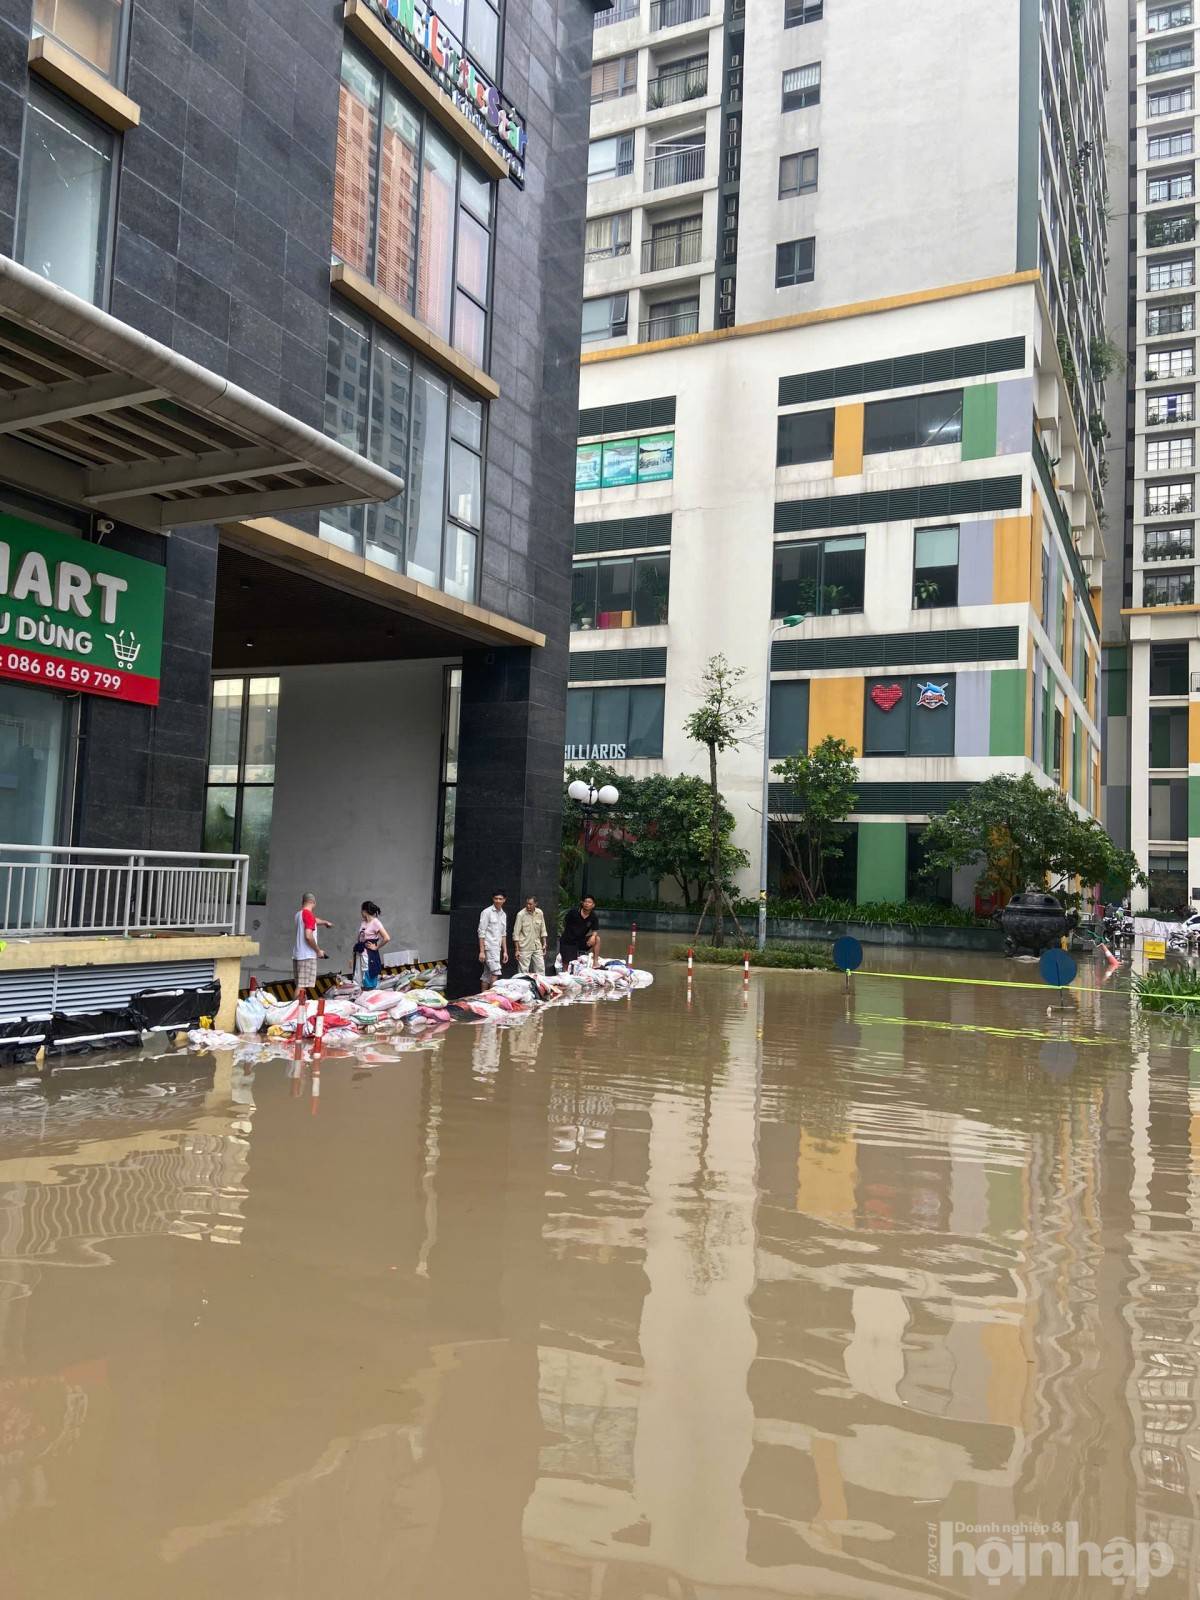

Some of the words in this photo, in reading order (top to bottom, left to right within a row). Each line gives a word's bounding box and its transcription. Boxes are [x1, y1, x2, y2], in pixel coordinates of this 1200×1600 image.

[0, 541, 128, 624] ART
[18, 614, 93, 654] DÙNG
[7, 653, 41, 674] 086
[45, 663, 66, 679] 86
[70, 667, 90, 683] 59
[94, 671, 121, 690] 799
